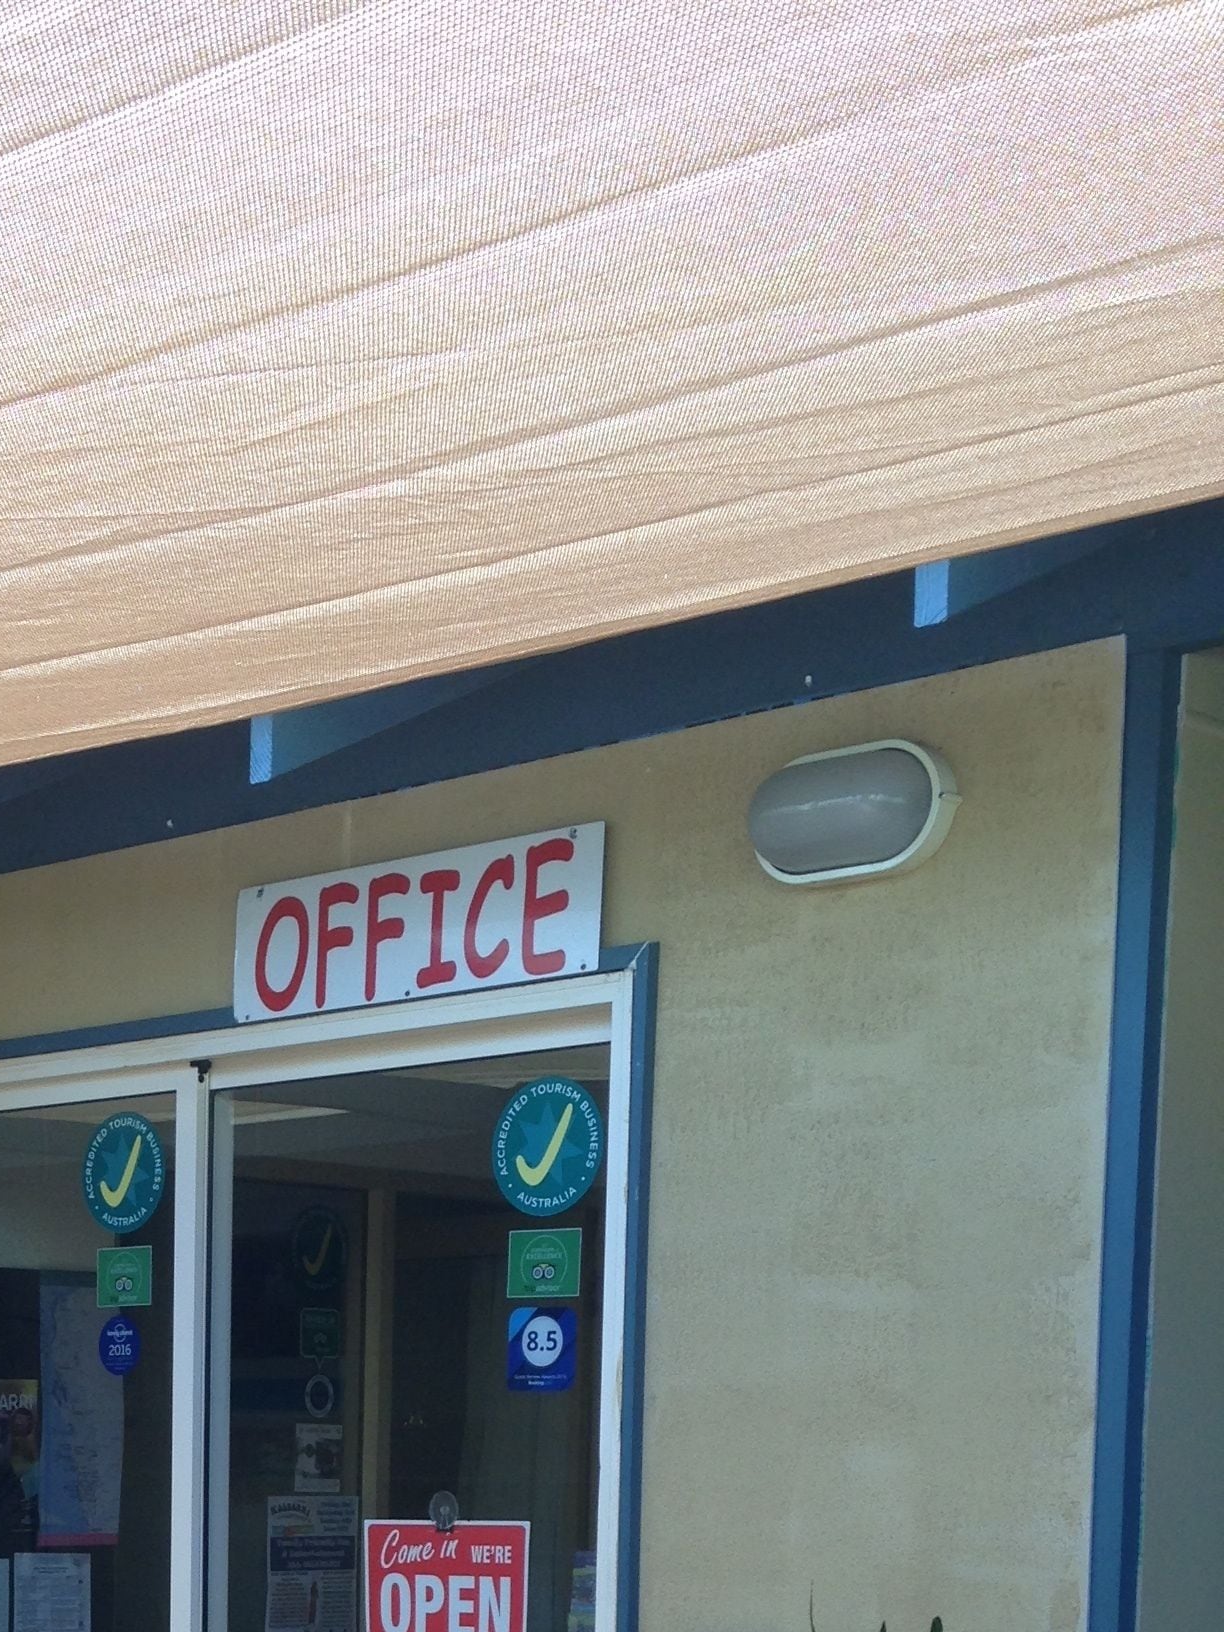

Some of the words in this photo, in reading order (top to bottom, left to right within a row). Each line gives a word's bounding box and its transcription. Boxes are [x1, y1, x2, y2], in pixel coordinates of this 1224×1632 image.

[255, 838, 575, 1012] OFFICE
[497, 1094, 529, 1176] ACCREDITED
[530, 1082, 581, 1102] TOURISM
[579, 1100, 599, 1170] BUSINESS
[86, 1128, 108, 1200] ACCREDITED
[109, 1117, 147, 1135] TOURISM
[146, 1131, 162, 1191] BUSINESS
[517, 1186, 577, 1208] AUSTRALIA
[102, 1206, 148, 1227] AUSTRALIA
[108, 1344, 131, 1356] 2016
[526, 1330, 557, 1351] 8.5
[380, 1529, 435, 1568] Come
[439, 1532, 458, 1560] in
[471, 1545, 512, 1564] WE'RE
